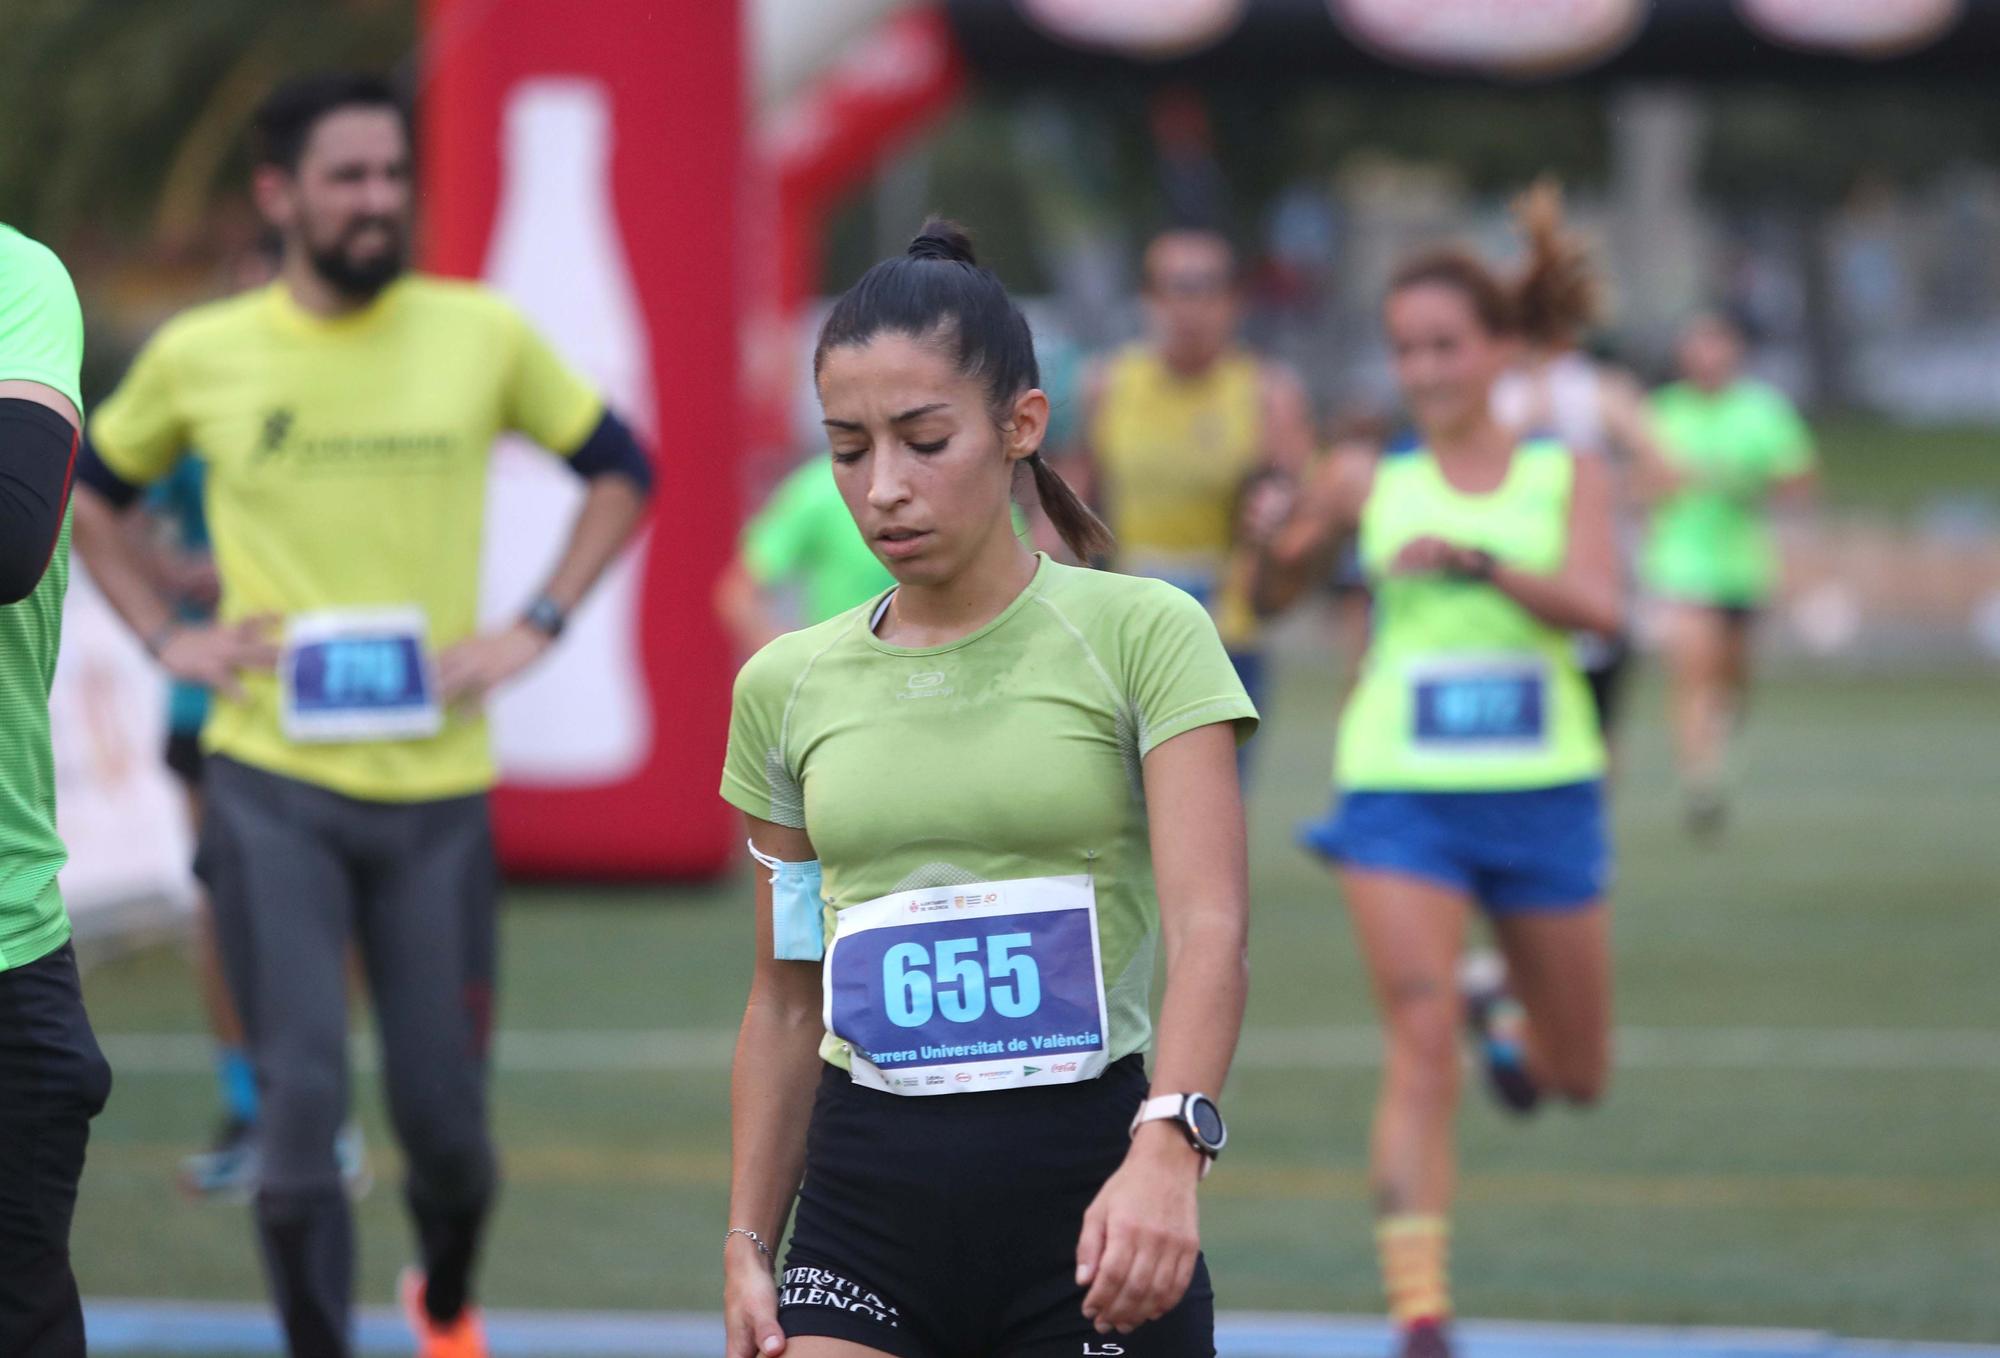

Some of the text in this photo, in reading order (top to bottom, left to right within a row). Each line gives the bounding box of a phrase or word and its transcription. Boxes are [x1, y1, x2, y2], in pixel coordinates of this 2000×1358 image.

[883, 932, 1041, 1028] 655
[920, 1038, 1005, 1060] Universitat
[1007, 1038, 1028, 1052] de
[1030, 1031, 1100, 1050] València
[1083, 1342, 1125, 1355] LS
